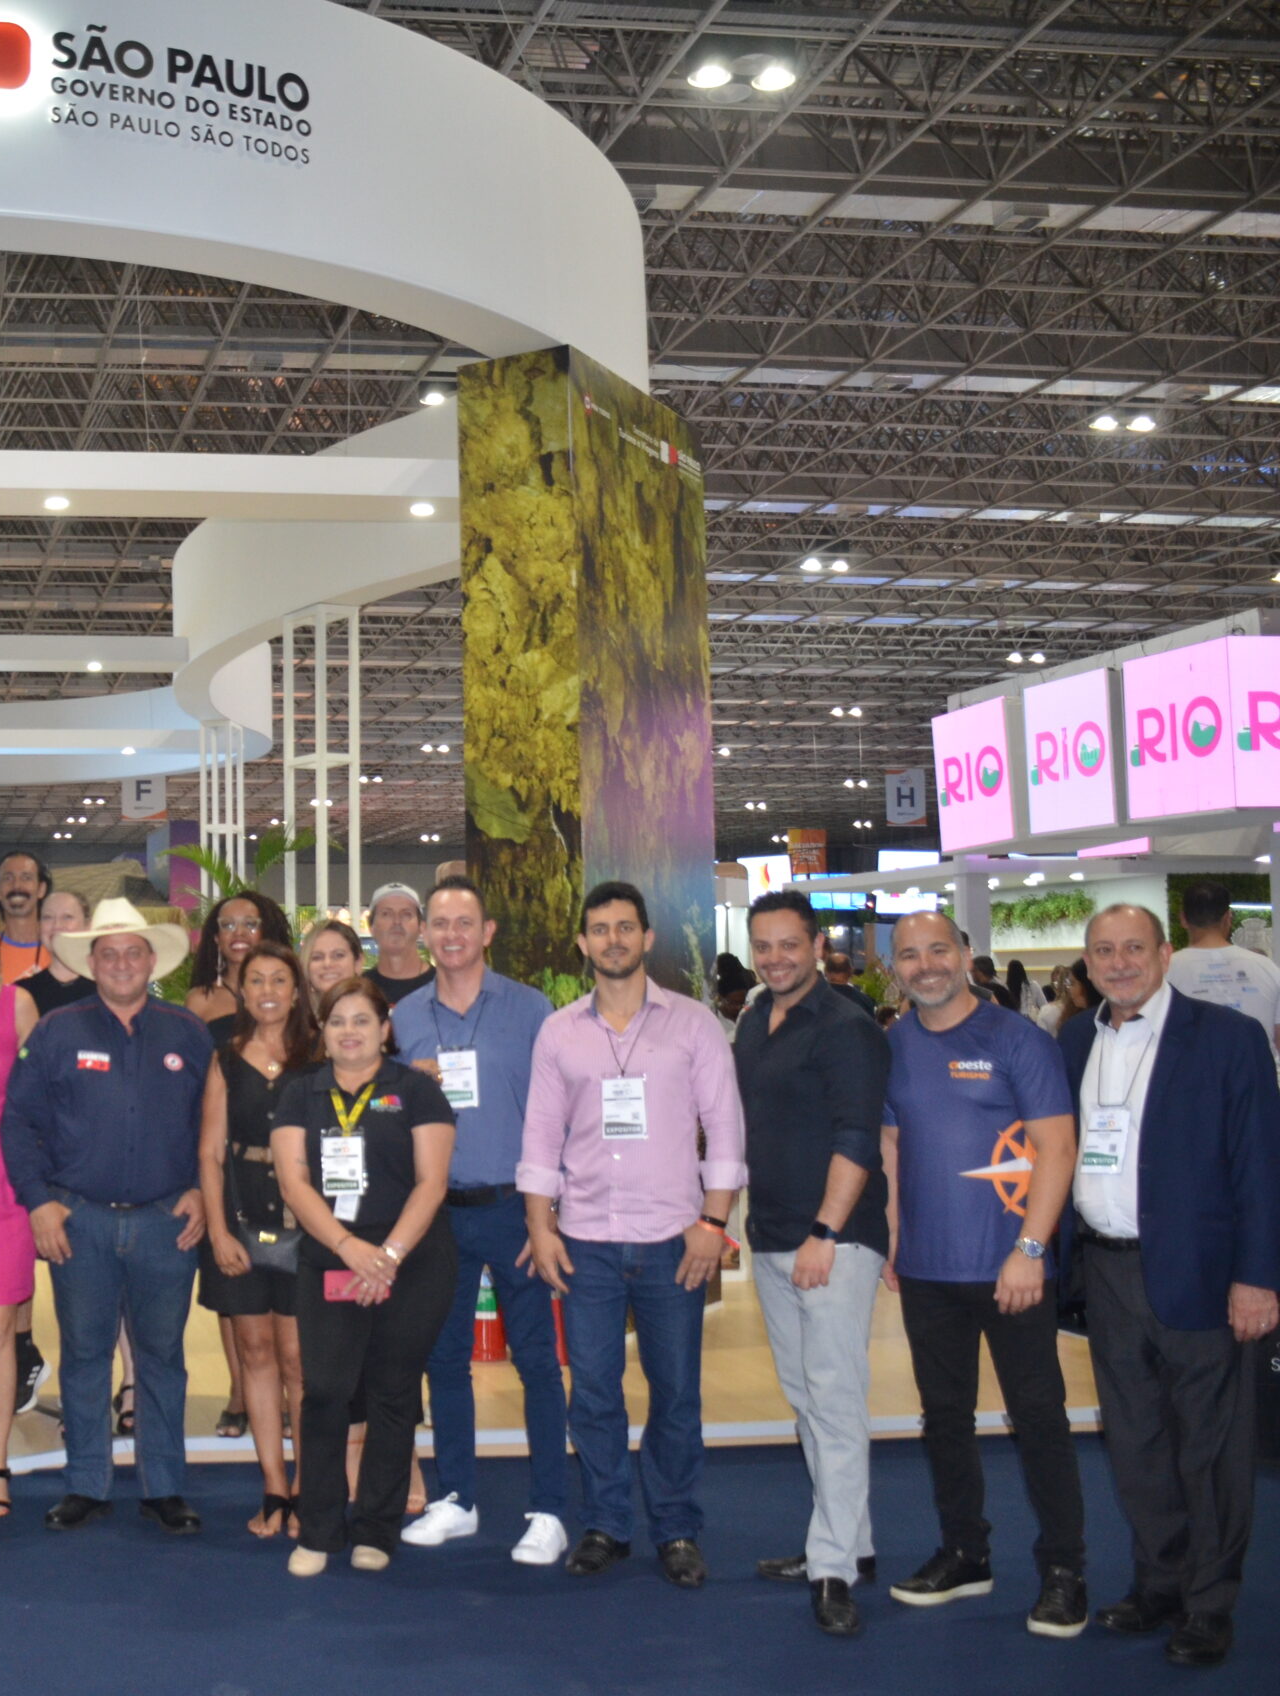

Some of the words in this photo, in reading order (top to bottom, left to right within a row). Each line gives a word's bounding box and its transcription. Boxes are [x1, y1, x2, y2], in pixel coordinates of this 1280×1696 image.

[51, 25, 154, 79] SÃO
[167, 47, 310, 113] PAULO
[50, 77, 176, 111] GOVERNO
[185, 101, 220, 118] DO
[227, 103, 313, 138] ESTADO
[50, 104, 99, 129] SÃO
[109, 113, 181, 139] PAULO
[190, 122, 234, 149] SÃO
[243, 134, 311, 166] TODOS
[1035, 720, 1106, 785] RIO
[1135, 695, 1222, 768] RIO
[135, 779, 152, 802] F
[896, 786, 915, 807] H
[942, 745, 1004, 807] RIO
